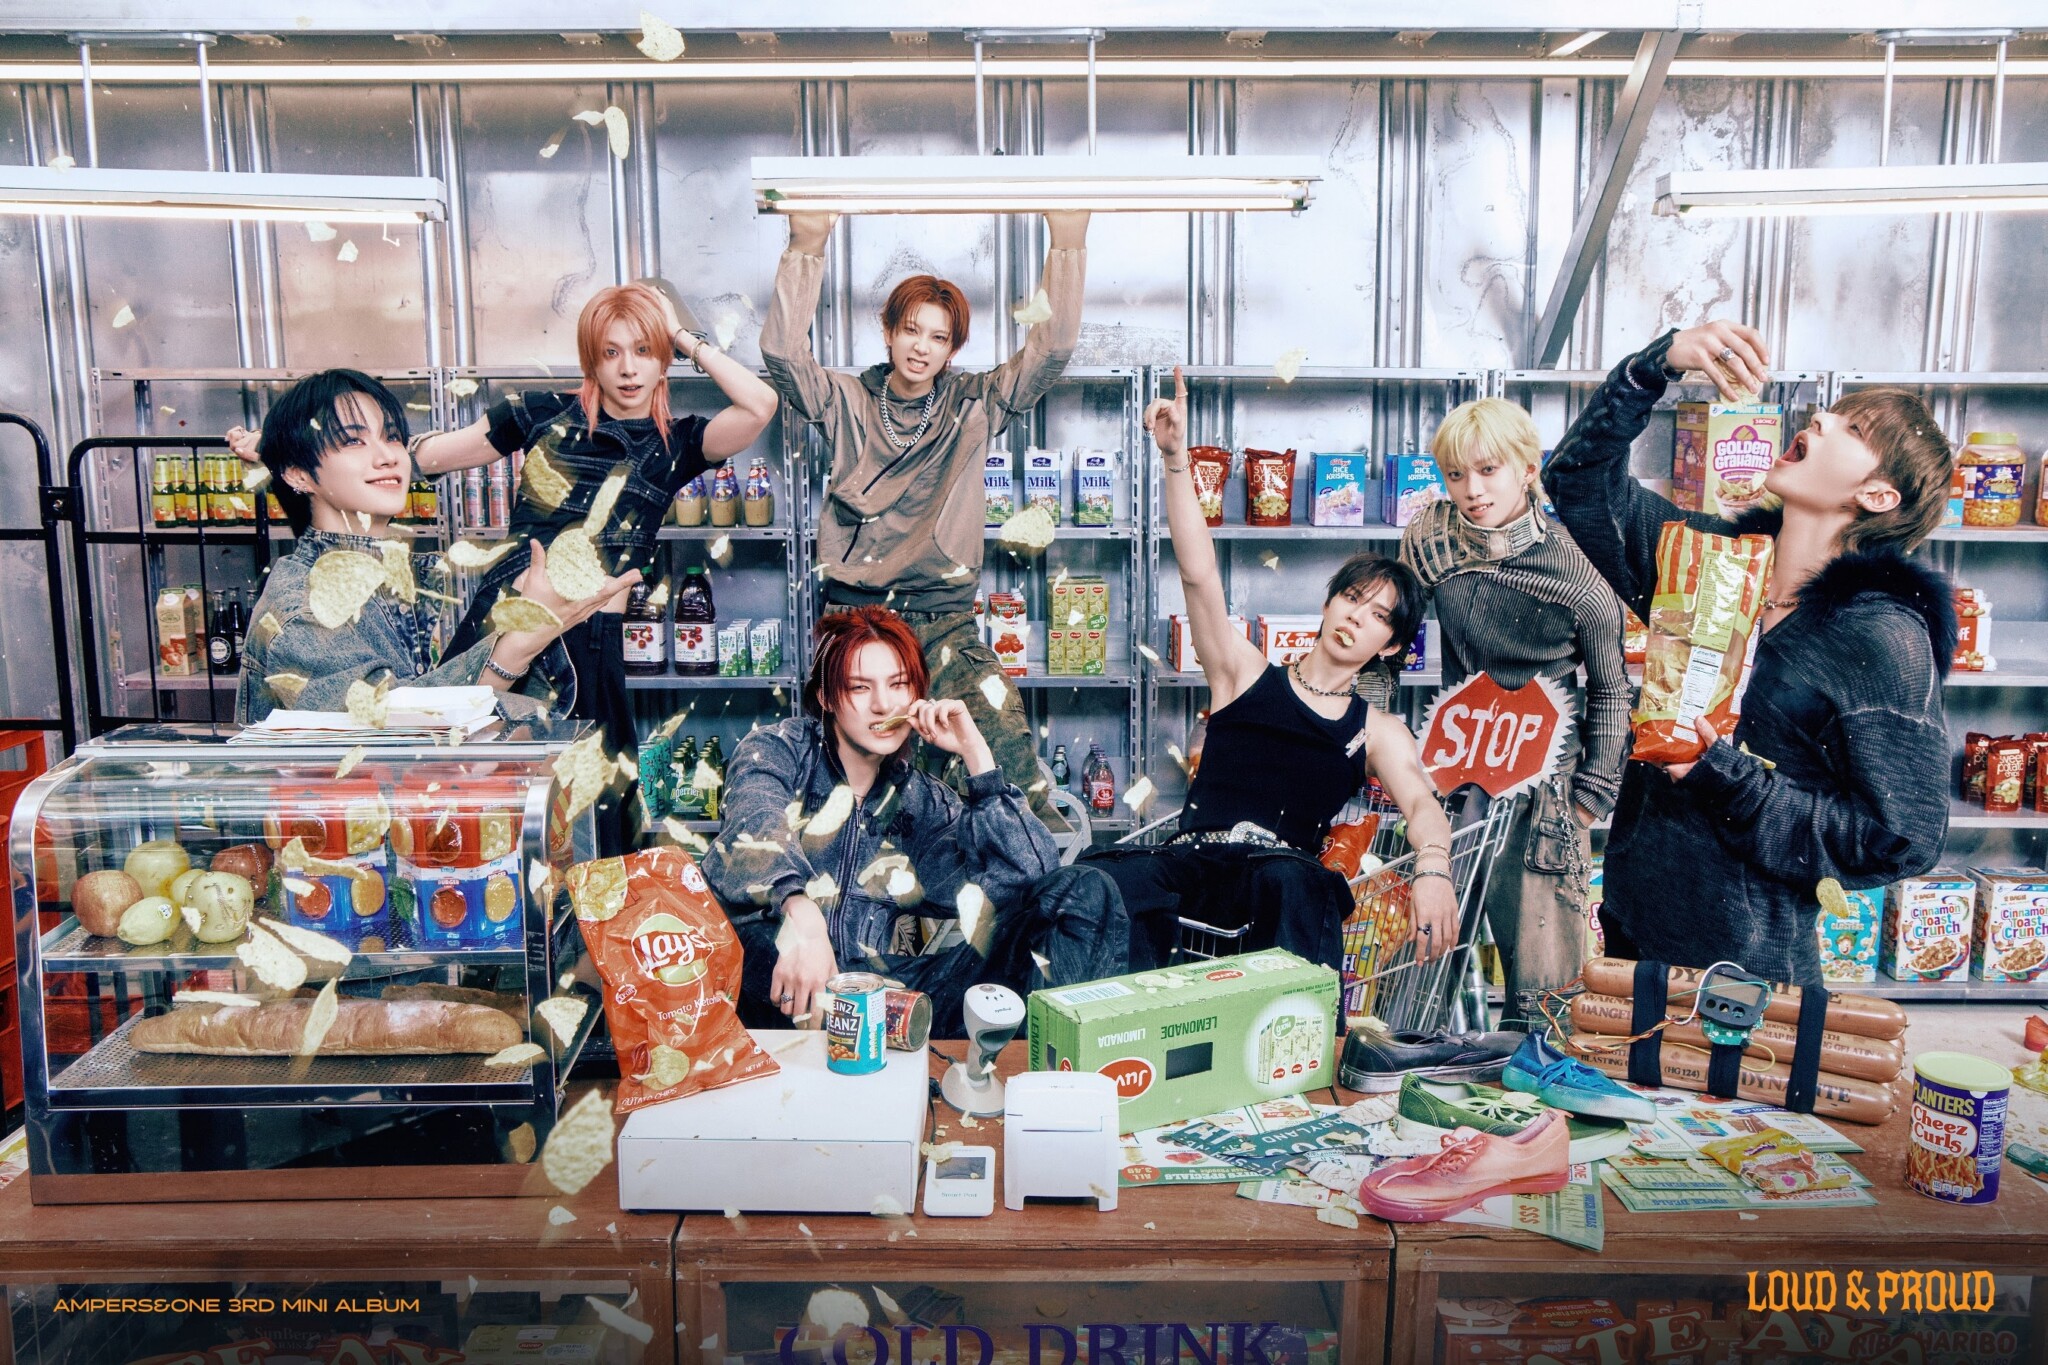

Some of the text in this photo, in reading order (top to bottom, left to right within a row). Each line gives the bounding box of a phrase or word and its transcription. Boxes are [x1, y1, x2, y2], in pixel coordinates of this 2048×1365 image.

[1326, 473, 1355, 481] KRISPIES
[1407, 474, 1437, 482] KRISPIES
[1414, 467, 1430, 475] RICE
[1027, 476, 1056, 488] Milk
[1082, 476, 1110, 488] Milk
[1276, 632, 1318, 647] X-ON
[1434, 699, 1543, 772] STOP
[1912, 903, 1961, 918] Cinnamon
[1920, 914, 1951, 926] Toast
[2011, 916, 2042, 928] Toast
[1914, 923, 1961, 938] Crunch
[656, 1003, 692, 1021] Tomato
[832, 1000, 853, 1015] EINZ
[1160, 1015, 1218, 1040] LEMONADE
[1031, 1014, 1040, 1072] LEMONA
[1097, 1027, 1146, 1048] LIMONADA
[1581, 1054, 1624, 1067] BLASTING
[1115, 1069, 1149, 1087] Juv
[1664, 1066, 1700, 1078] (HG 124)
[1913, 1105, 1969, 1137] Cheez
[1262, 1117, 1345, 1144] ARYLAND
[1913, 1122, 1963, 1154] Curls
[1134, 1173, 1152, 1181] ALL
[1165, 1172, 1227, 1181] SPECIALS
[779, 1321, 1281, 1365] COLD DRINK
